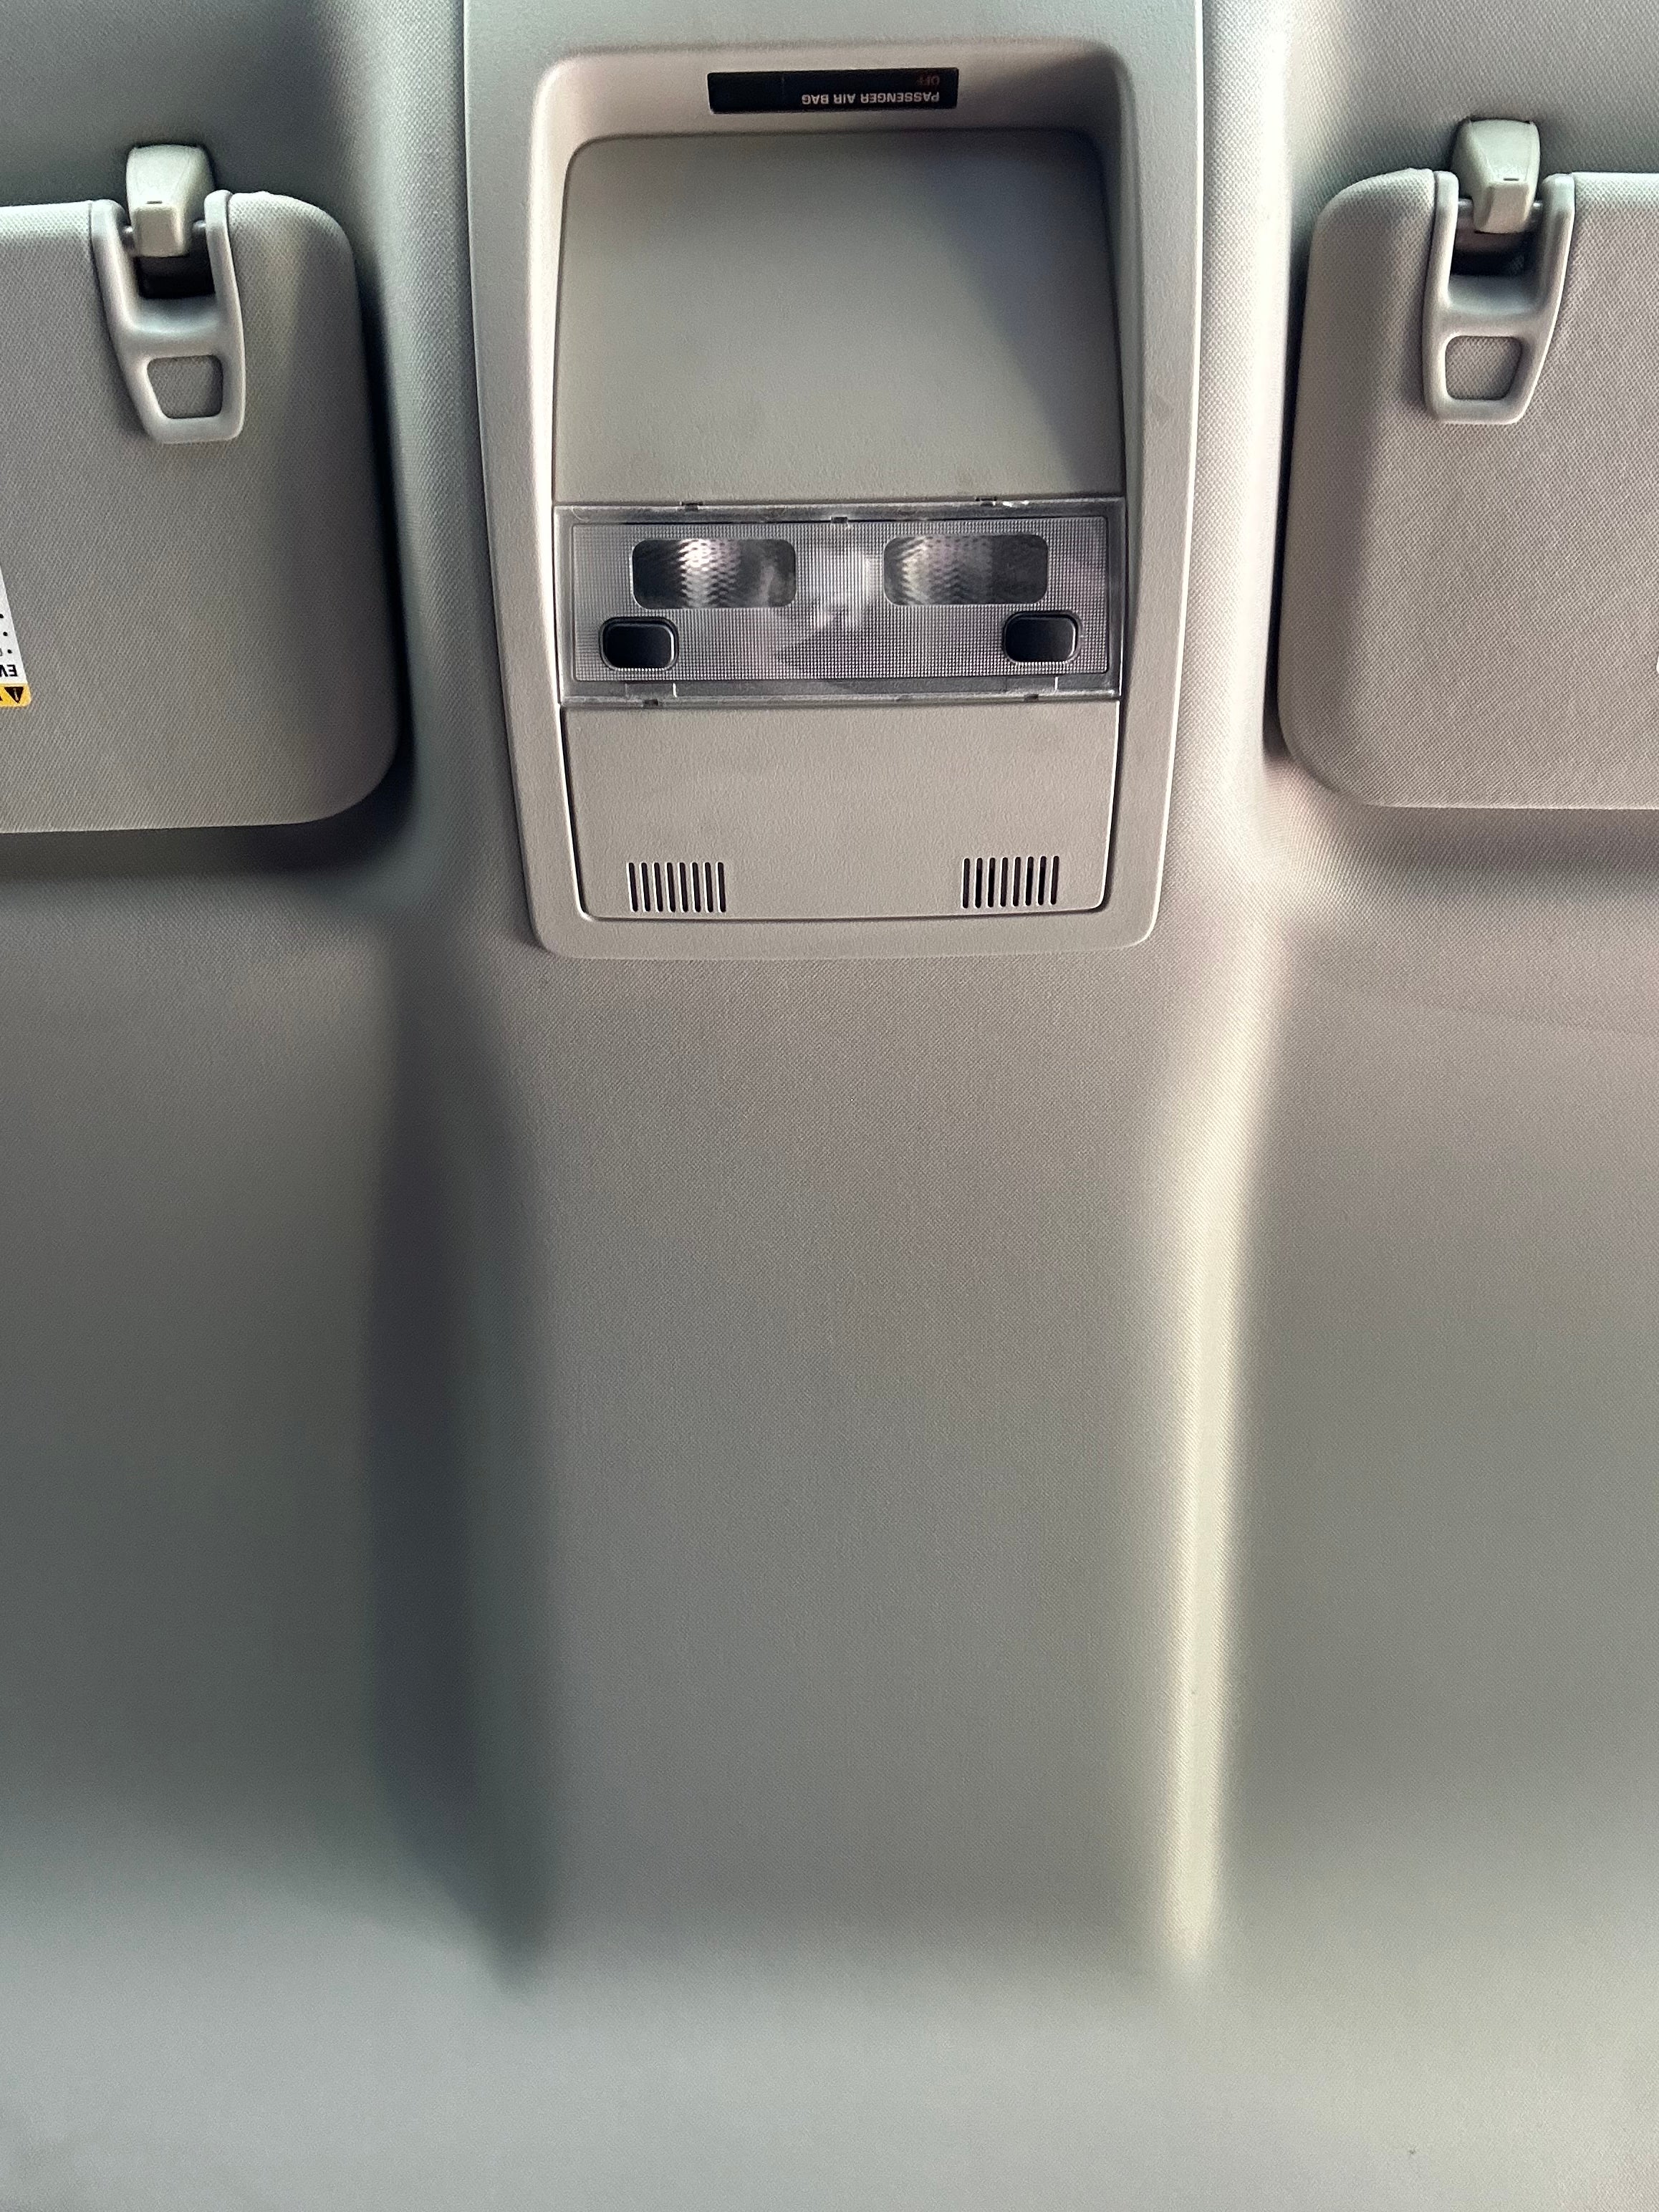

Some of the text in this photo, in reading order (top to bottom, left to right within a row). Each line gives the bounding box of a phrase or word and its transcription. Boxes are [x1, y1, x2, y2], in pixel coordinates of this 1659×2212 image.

[918, 74, 940, 86] OFF
[802, 91, 940, 105] PASSENGER AIR BAG
